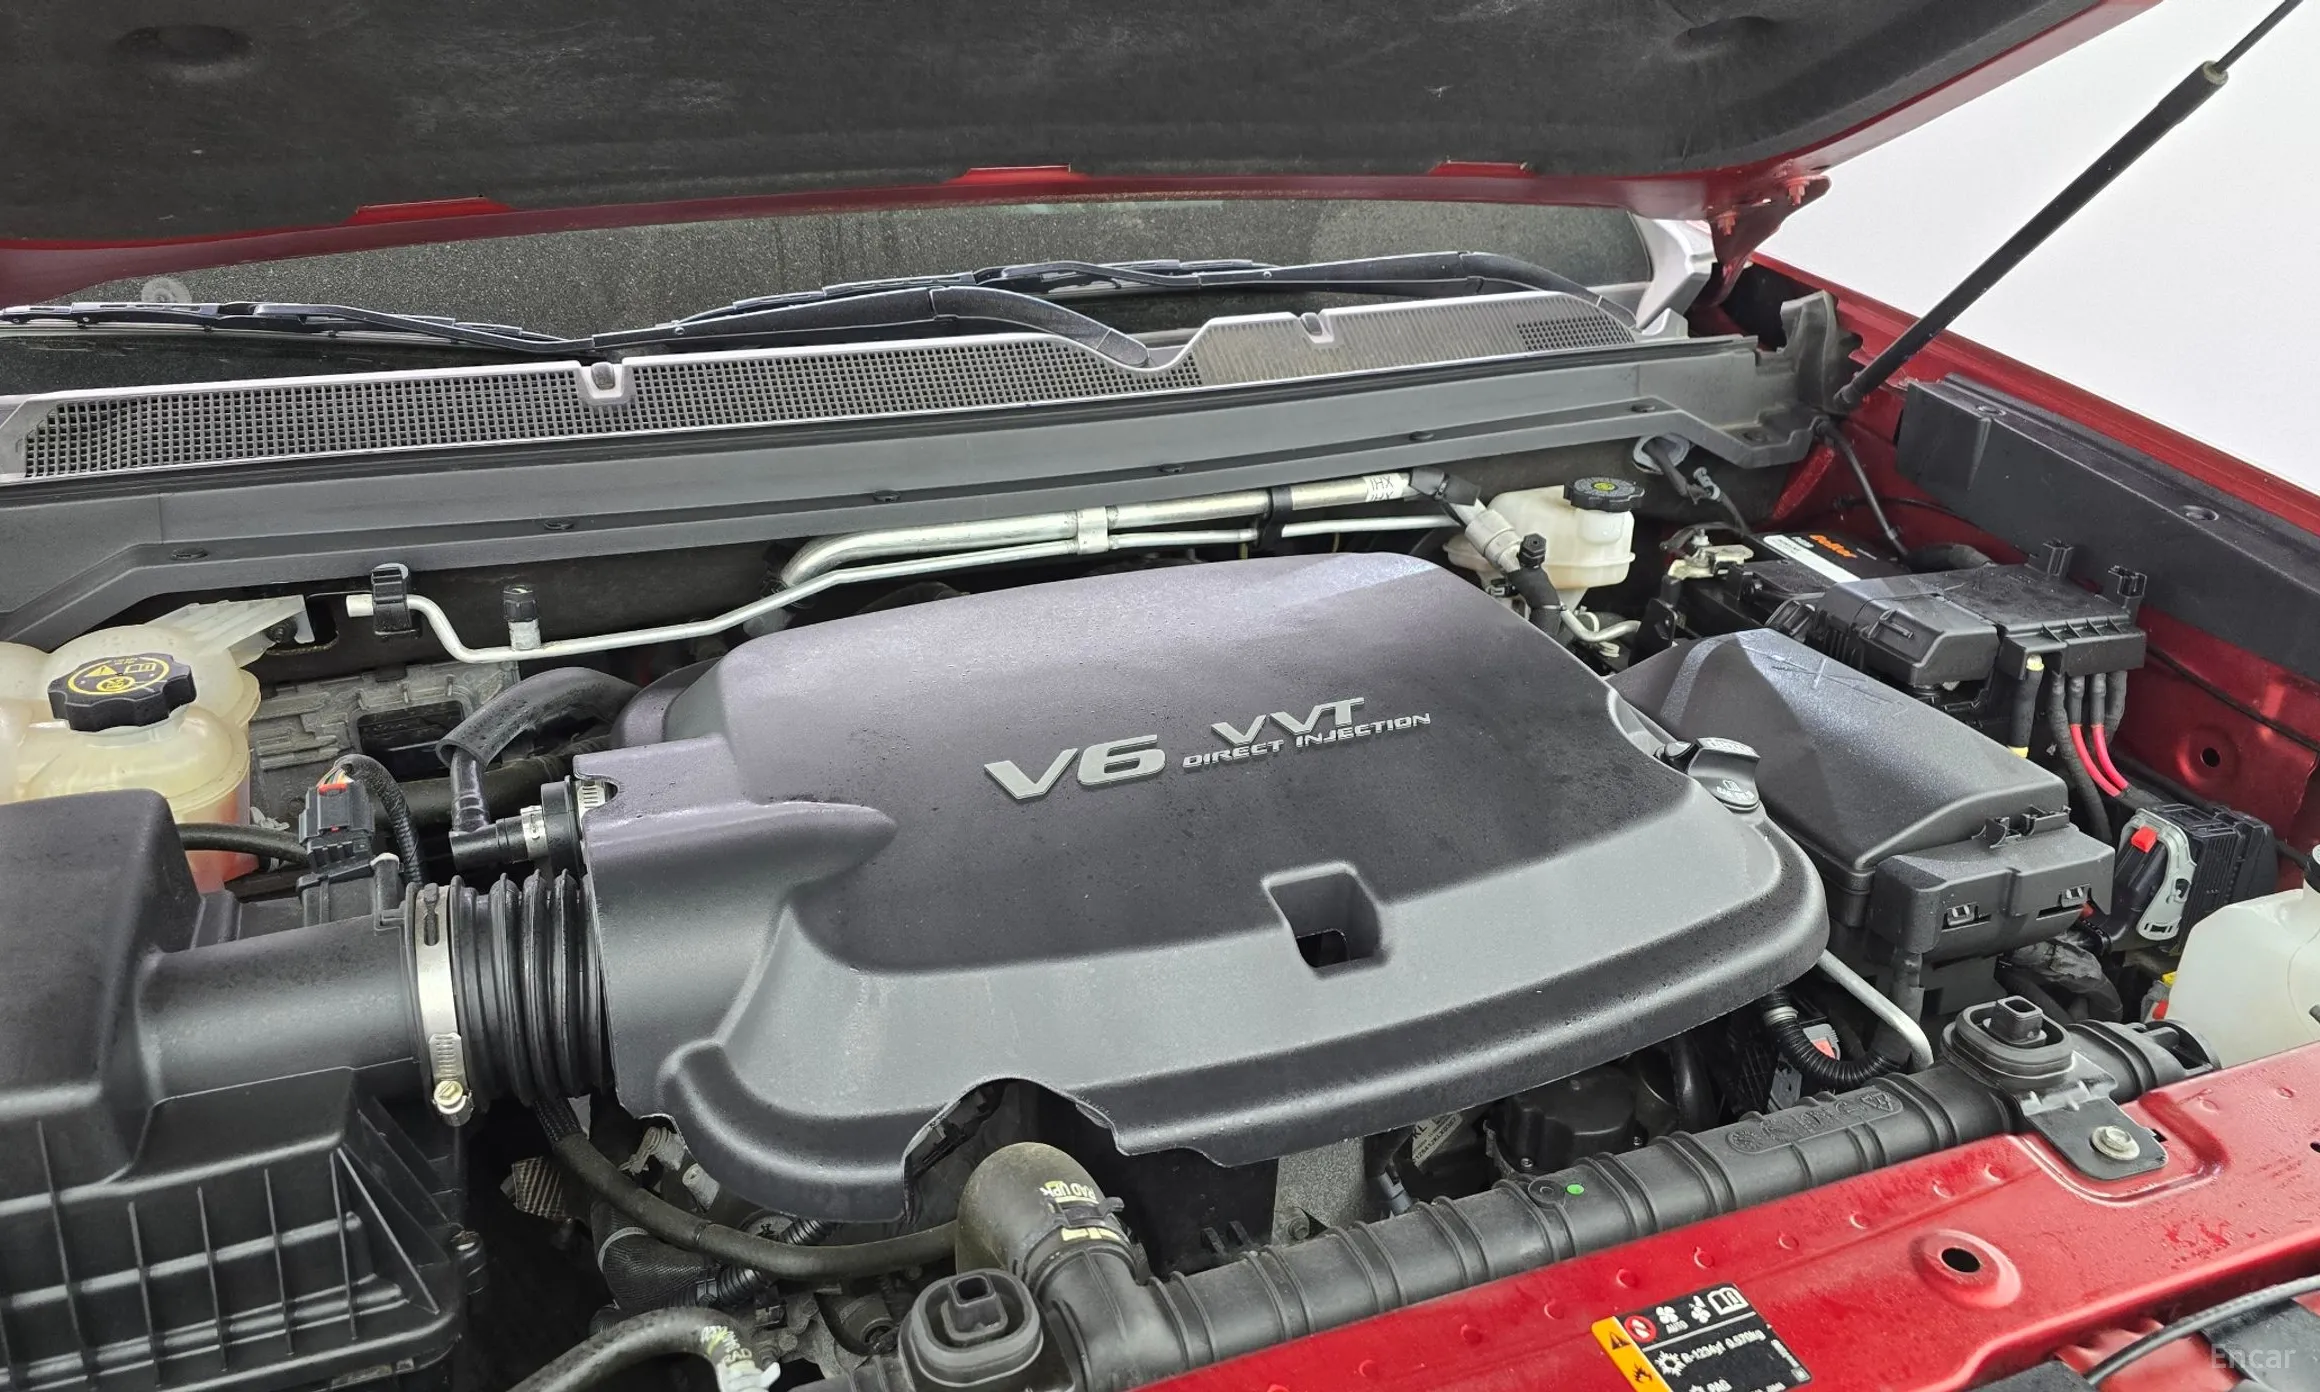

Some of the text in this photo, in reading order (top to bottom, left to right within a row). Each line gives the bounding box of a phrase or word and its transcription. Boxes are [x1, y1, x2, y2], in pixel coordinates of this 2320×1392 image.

[984, 697, 1364, 800] V6 VVT
[1182, 713, 1431, 768] DIRECT INJECTION
[1070, 1183, 1097, 1201] RAD
[1666, 1320, 1689, 1334] AUTO
